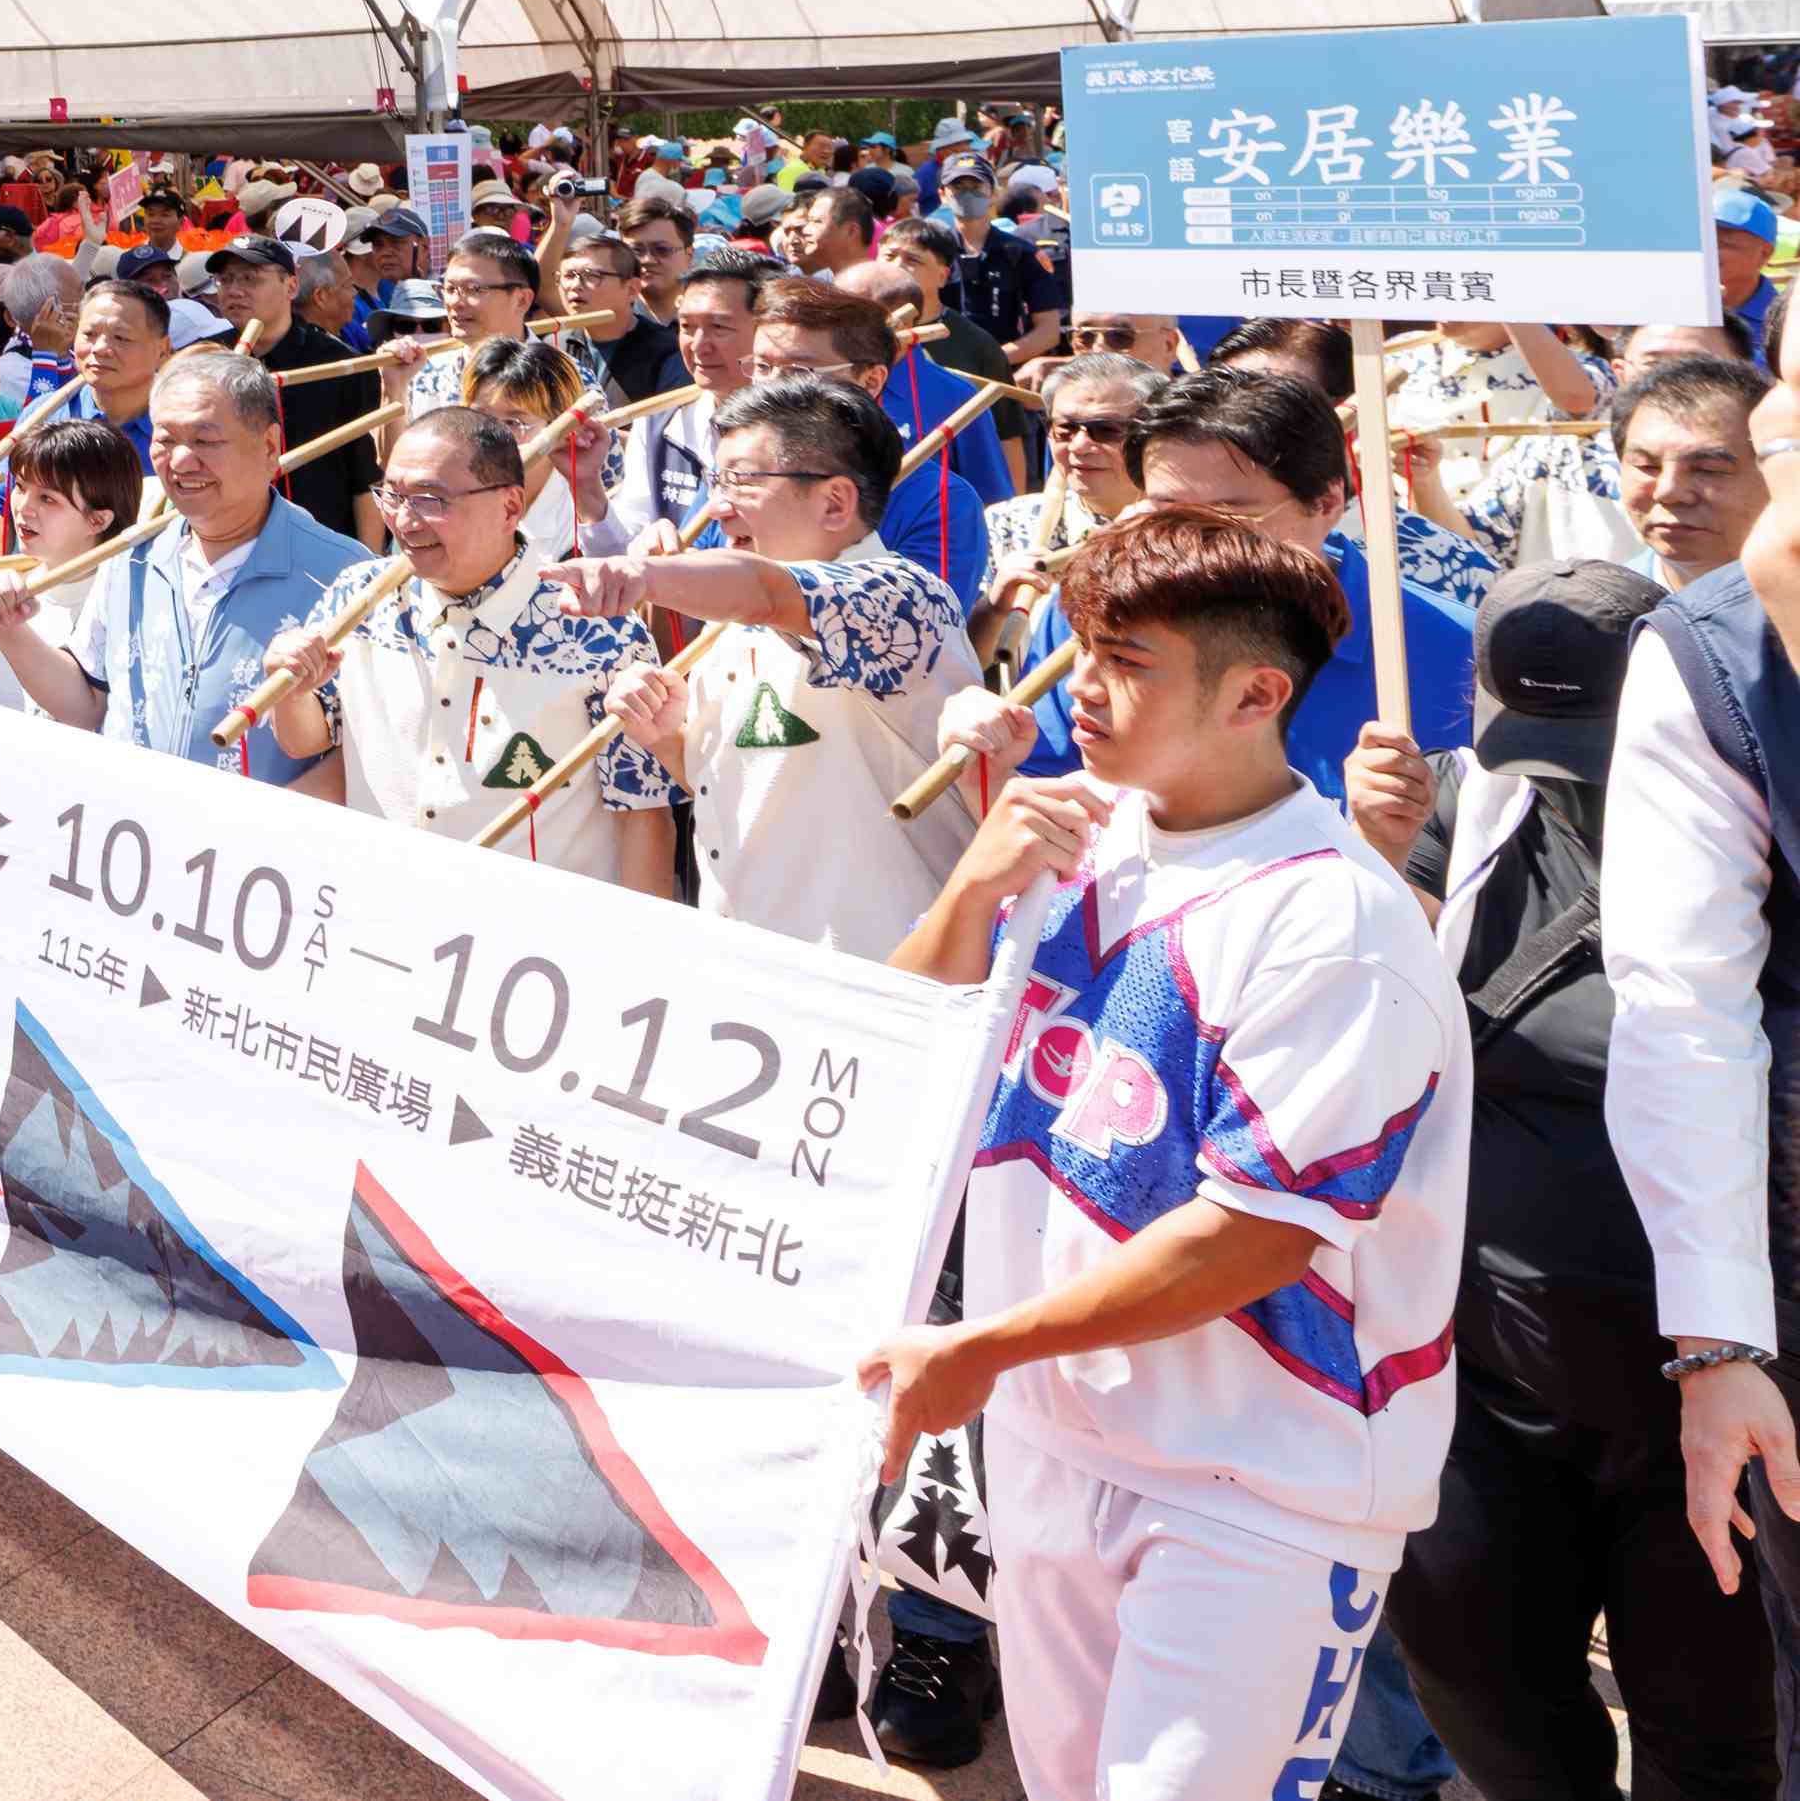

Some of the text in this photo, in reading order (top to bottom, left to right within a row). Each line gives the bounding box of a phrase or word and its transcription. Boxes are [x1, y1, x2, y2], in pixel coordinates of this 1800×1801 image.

[1166, 119, 1197, 184] 客語
[1198, 92, 1578, 186] 安居樂業
[1240, 268, 1497, 302] 市長暨各界貴賓
[49, 803, 293, 971] 10.10
[303, 885, 337, 992] SAT
[412, 934, 781, 1160] 10.12
[791, 1048, 858, 1187] MON
[38, 928, 804, 1287] 115年 新北市民廣場 義起挺新北
